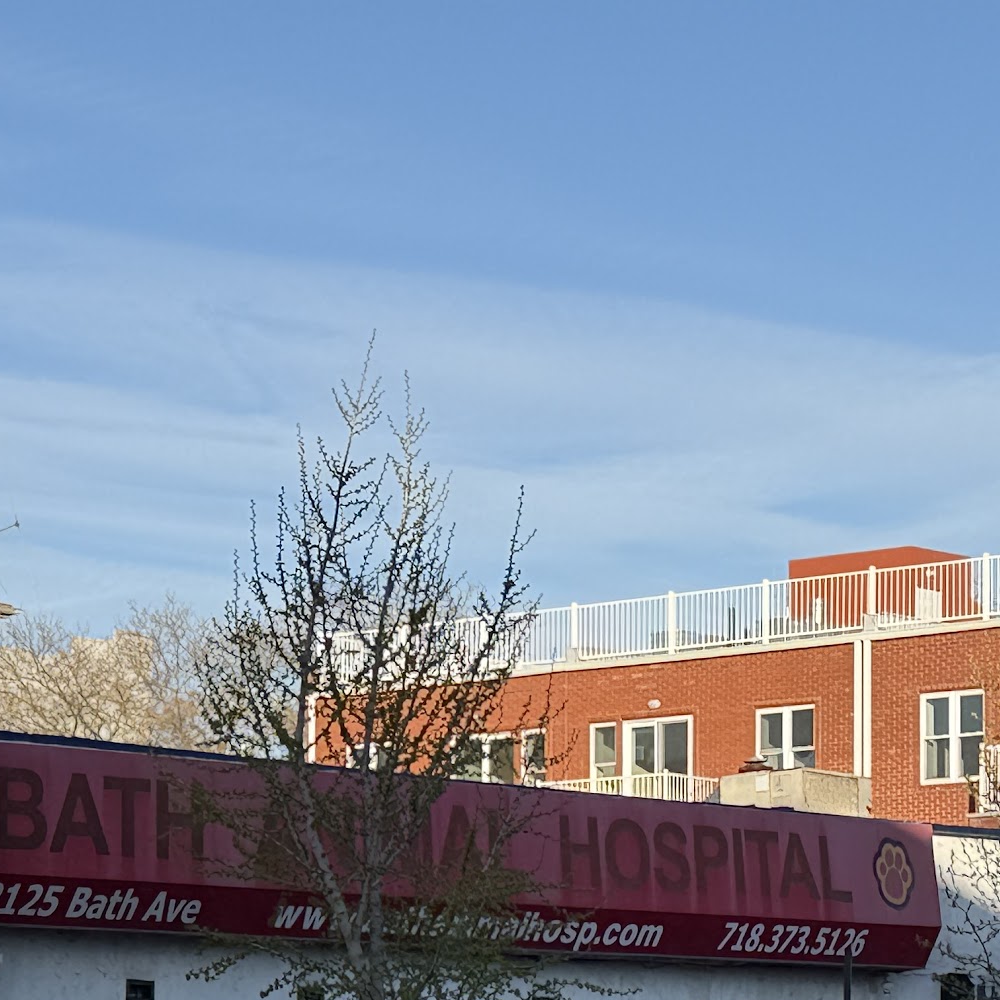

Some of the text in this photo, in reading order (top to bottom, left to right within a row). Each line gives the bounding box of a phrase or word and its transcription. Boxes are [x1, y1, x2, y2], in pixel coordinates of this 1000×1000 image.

[559, 814, 854, 904] HOSPITAL
[65, 886, 140, 921] Bath
[141, 891, 202, 924] Ave
[717, 922, 870, 957] 718.373.5126
